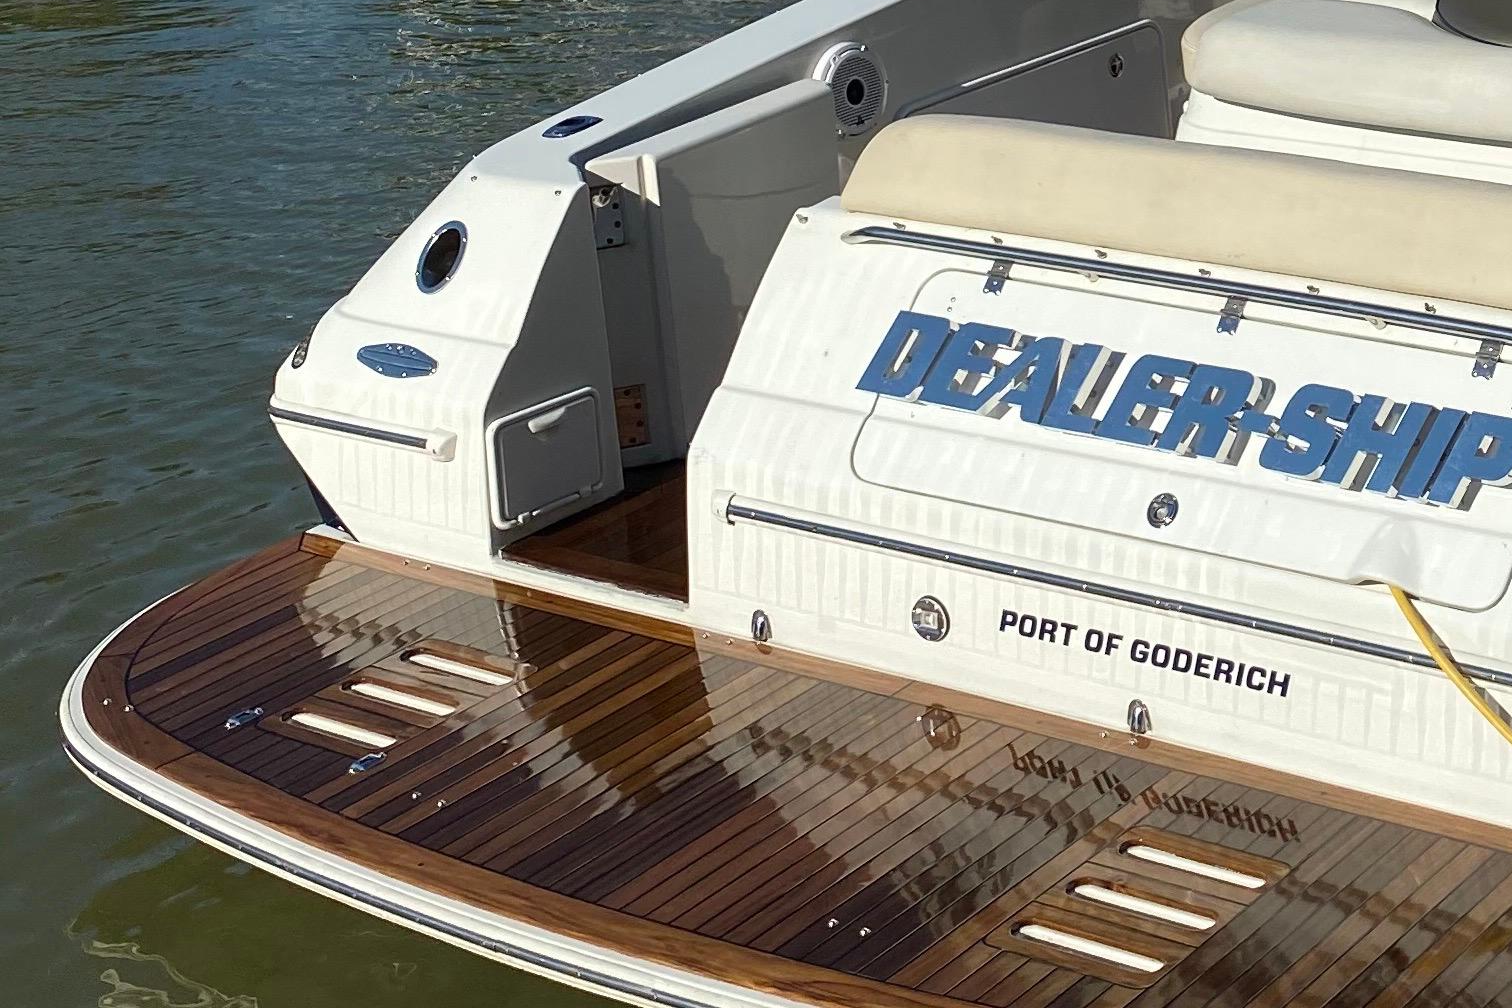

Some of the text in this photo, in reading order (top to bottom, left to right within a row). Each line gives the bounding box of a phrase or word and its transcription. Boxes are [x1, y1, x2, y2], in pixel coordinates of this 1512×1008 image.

[1000, 609, 1291, 697] PORT OF GODERICH
